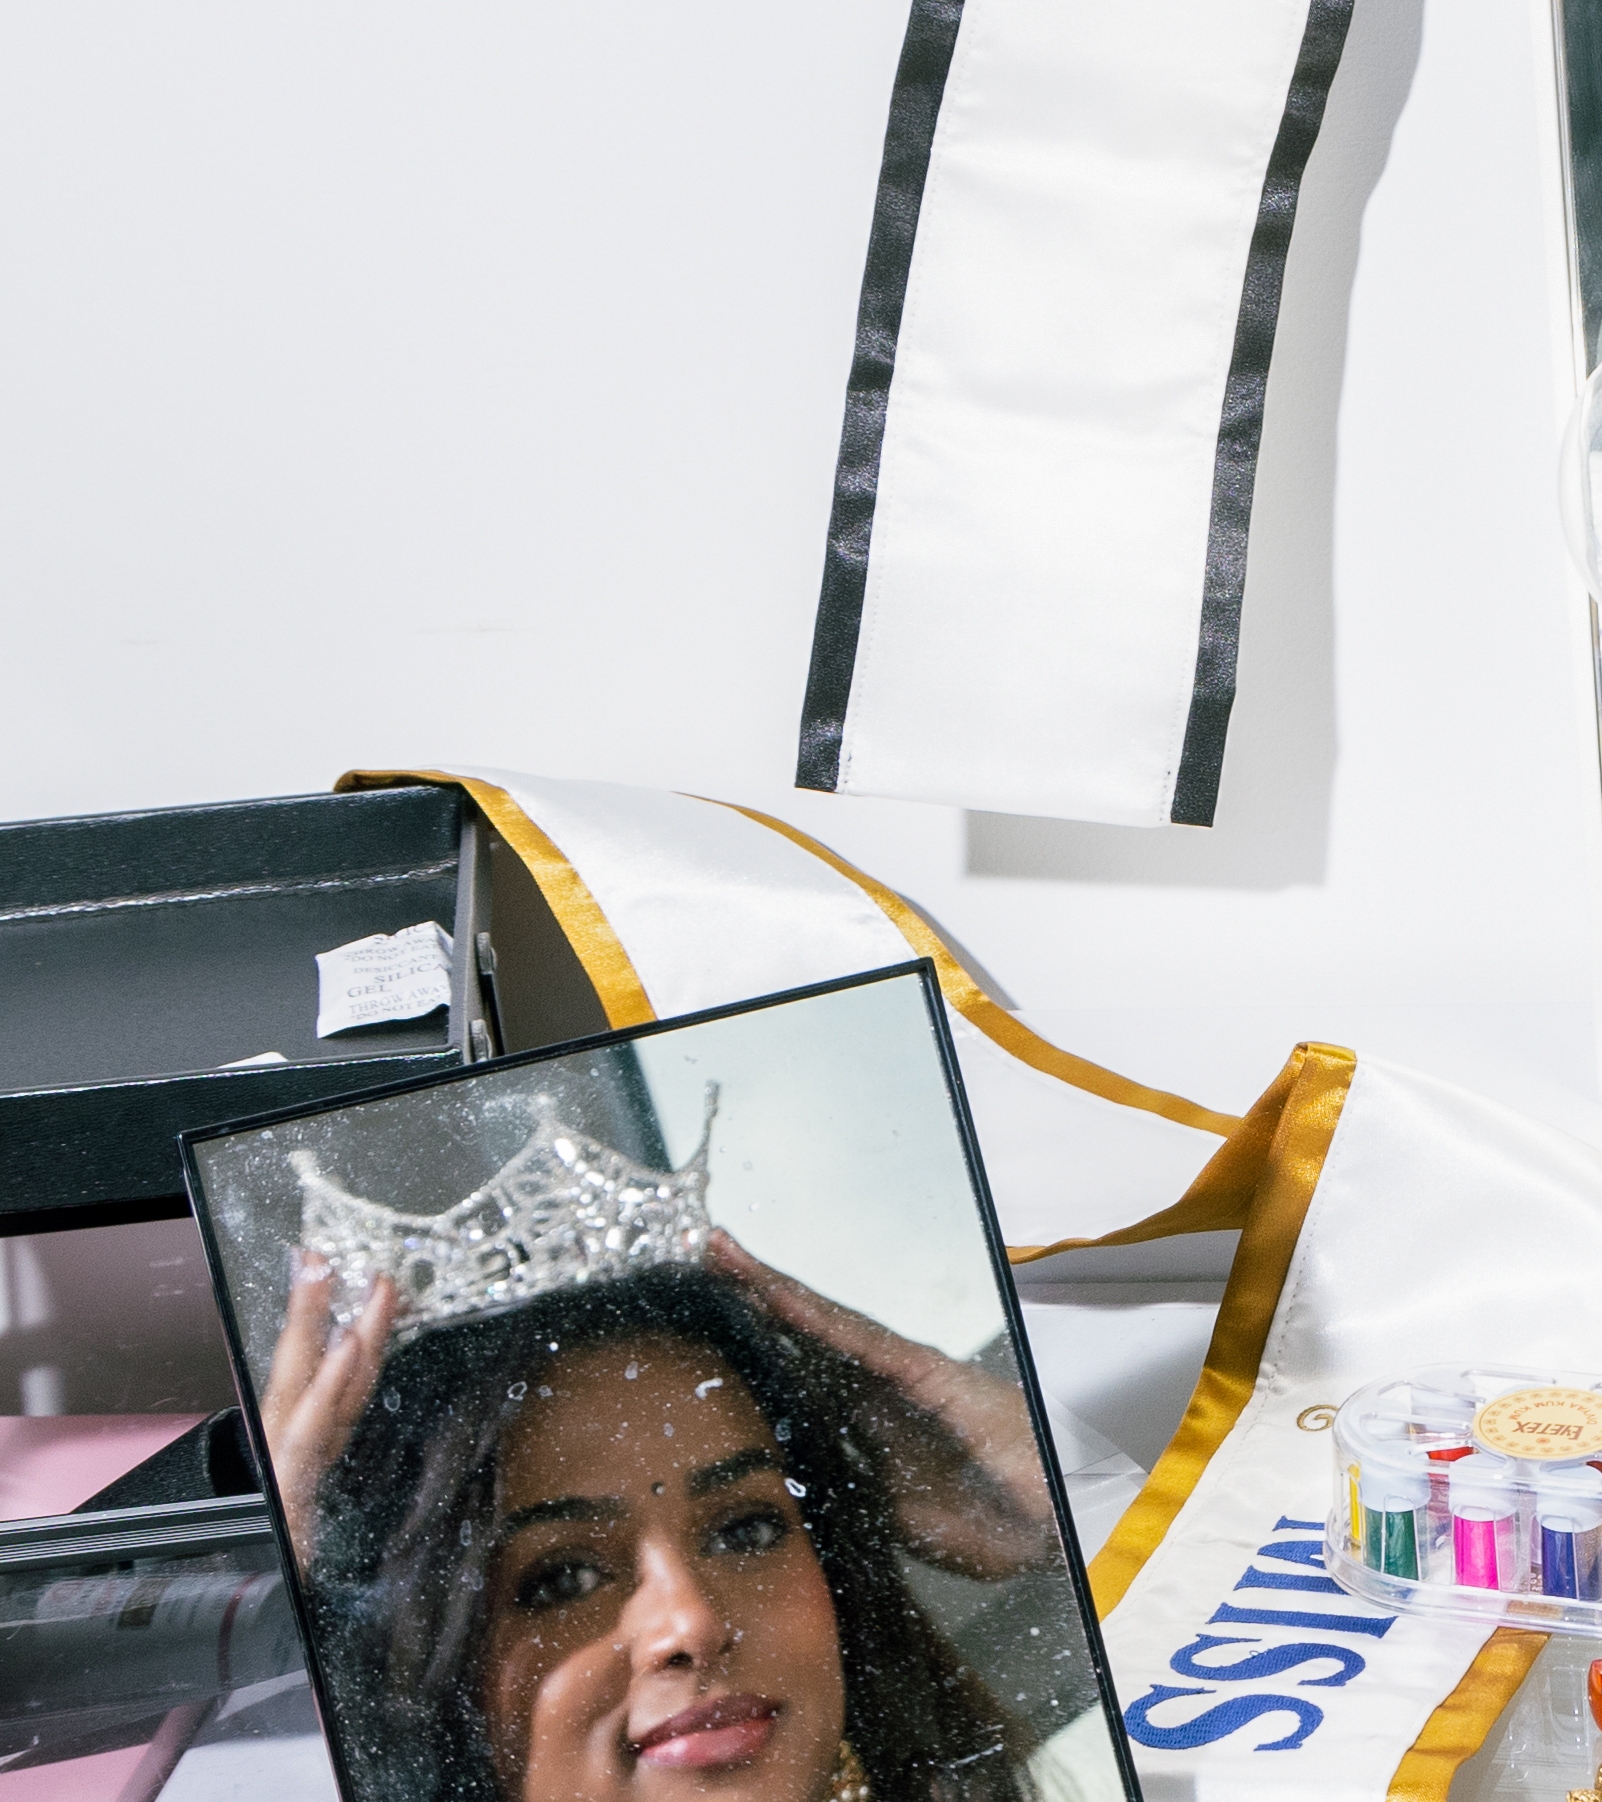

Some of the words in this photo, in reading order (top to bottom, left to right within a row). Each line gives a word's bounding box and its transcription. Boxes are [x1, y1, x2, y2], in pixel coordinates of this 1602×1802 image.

[374, 963, 444, 983] SILICA
[347, 984, 391, 998] GEL
[349, 994, 404, 1014] THROW
[1534, 1400, 1565, 1408] KUM
[1124, 1512, 1398, 1752] MISS
